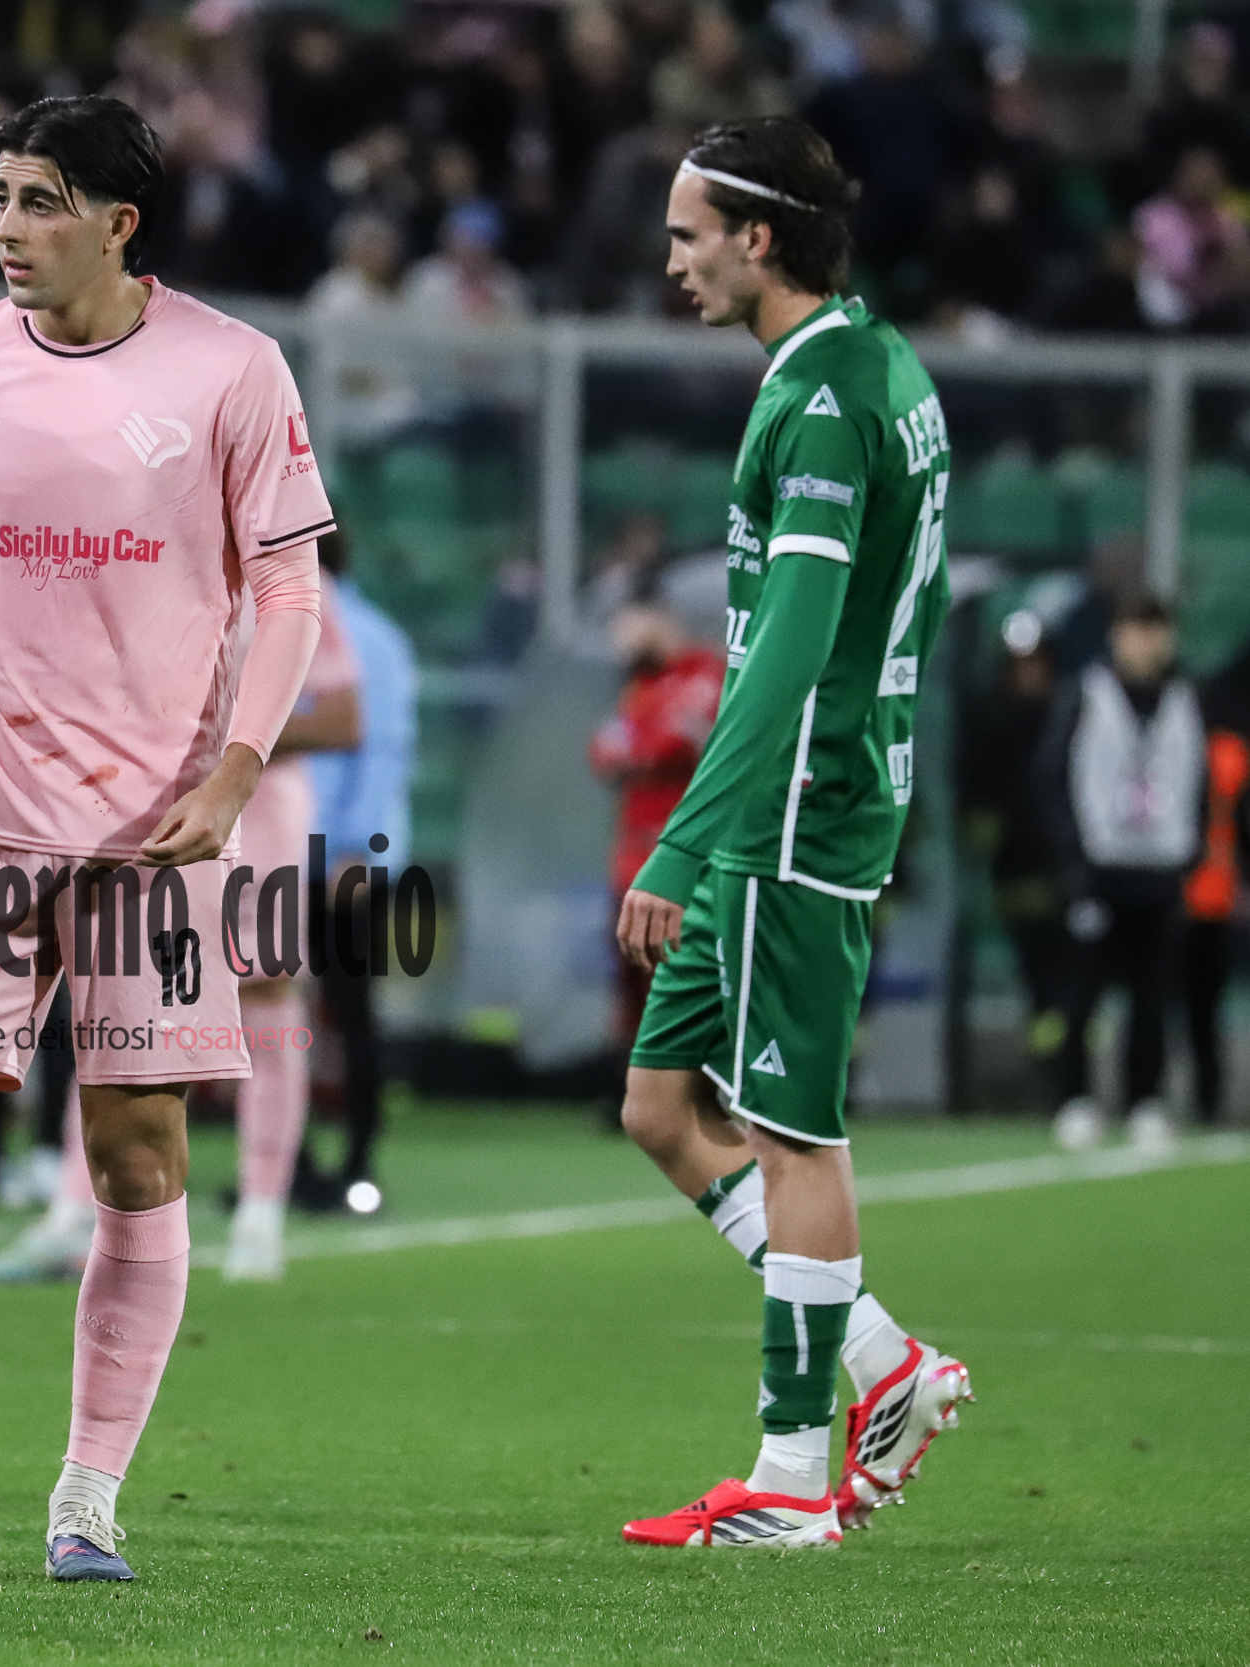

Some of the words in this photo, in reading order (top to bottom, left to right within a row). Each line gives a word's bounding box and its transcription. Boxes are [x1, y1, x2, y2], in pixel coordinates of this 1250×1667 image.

[19, 557, 51, 591] My
[56, 557, 99, 580] Love
[153, 928, 202, 1007] 10
